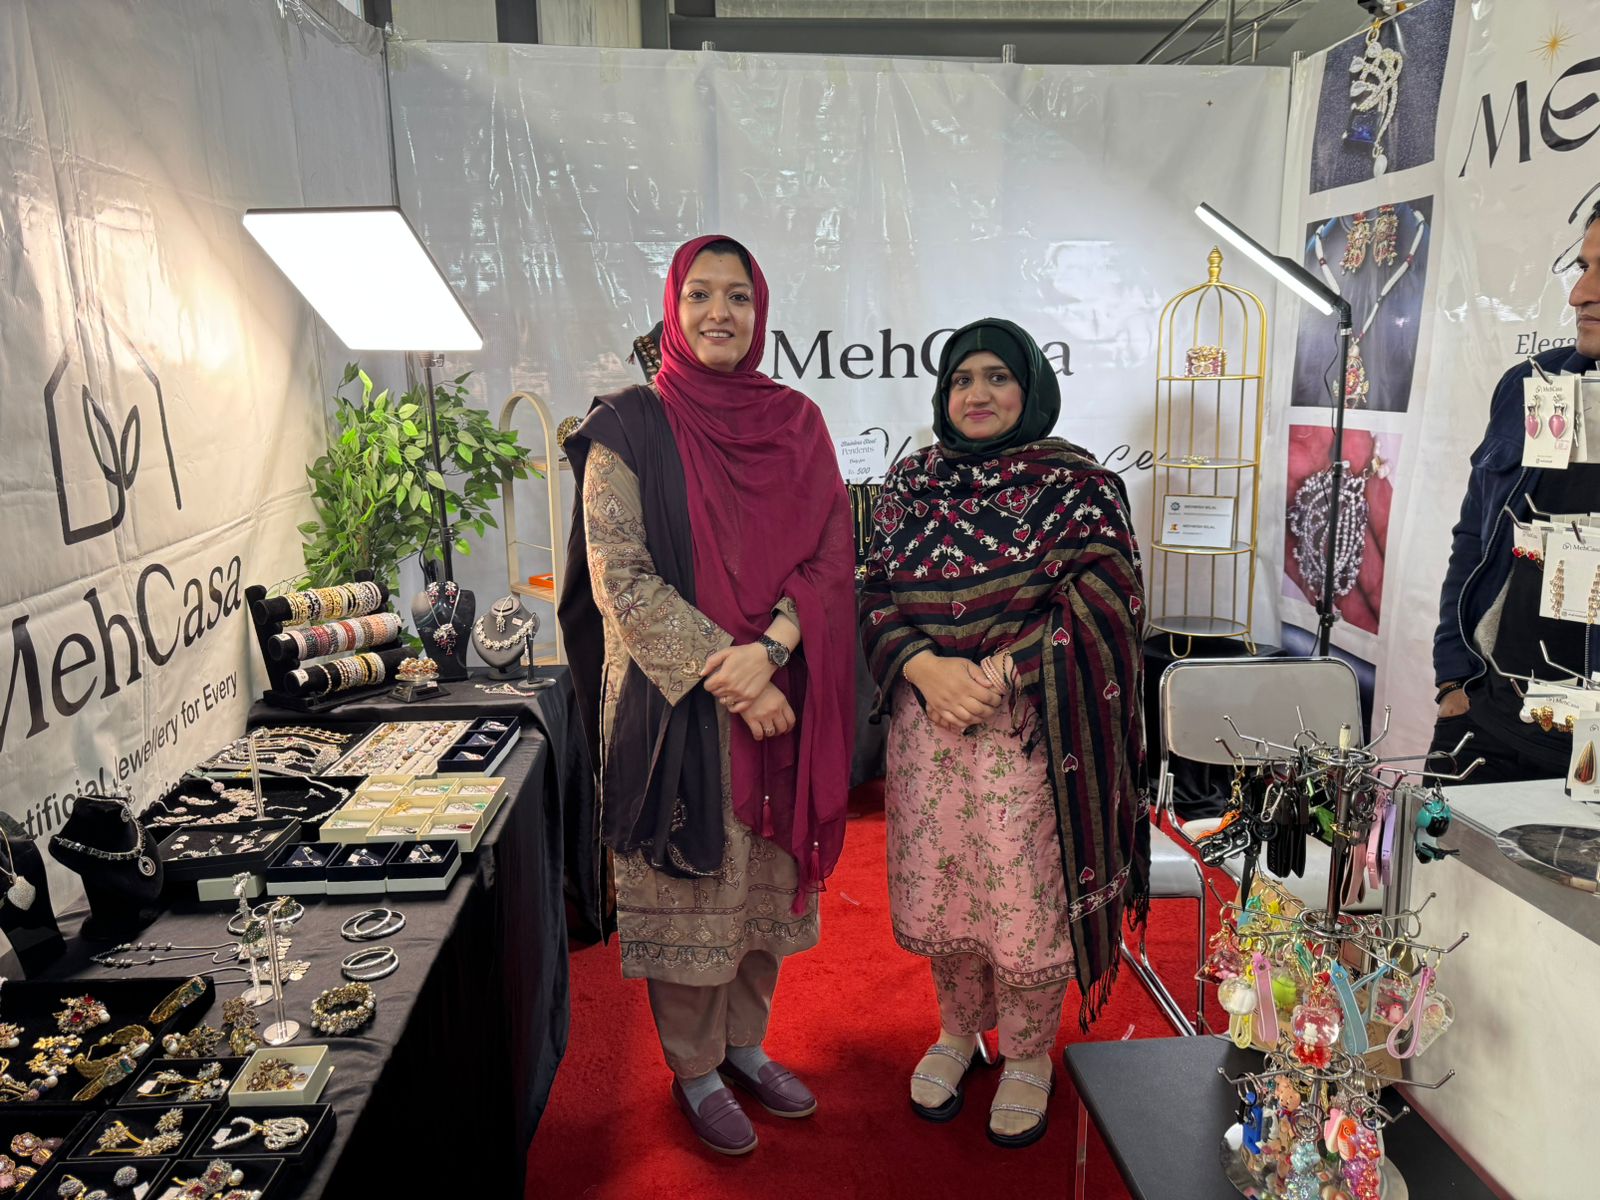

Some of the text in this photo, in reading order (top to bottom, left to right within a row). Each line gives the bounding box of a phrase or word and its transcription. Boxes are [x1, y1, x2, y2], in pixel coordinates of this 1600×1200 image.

[770, 328, 1074, 380] MehCa
[856, 467, 871, 475] 500
[19, 766, 106, 840] tificial
[112, 714, 179, 789] Jewellery
[181, 700, 200, 729] for
[202, 671, 237, 712] Every
